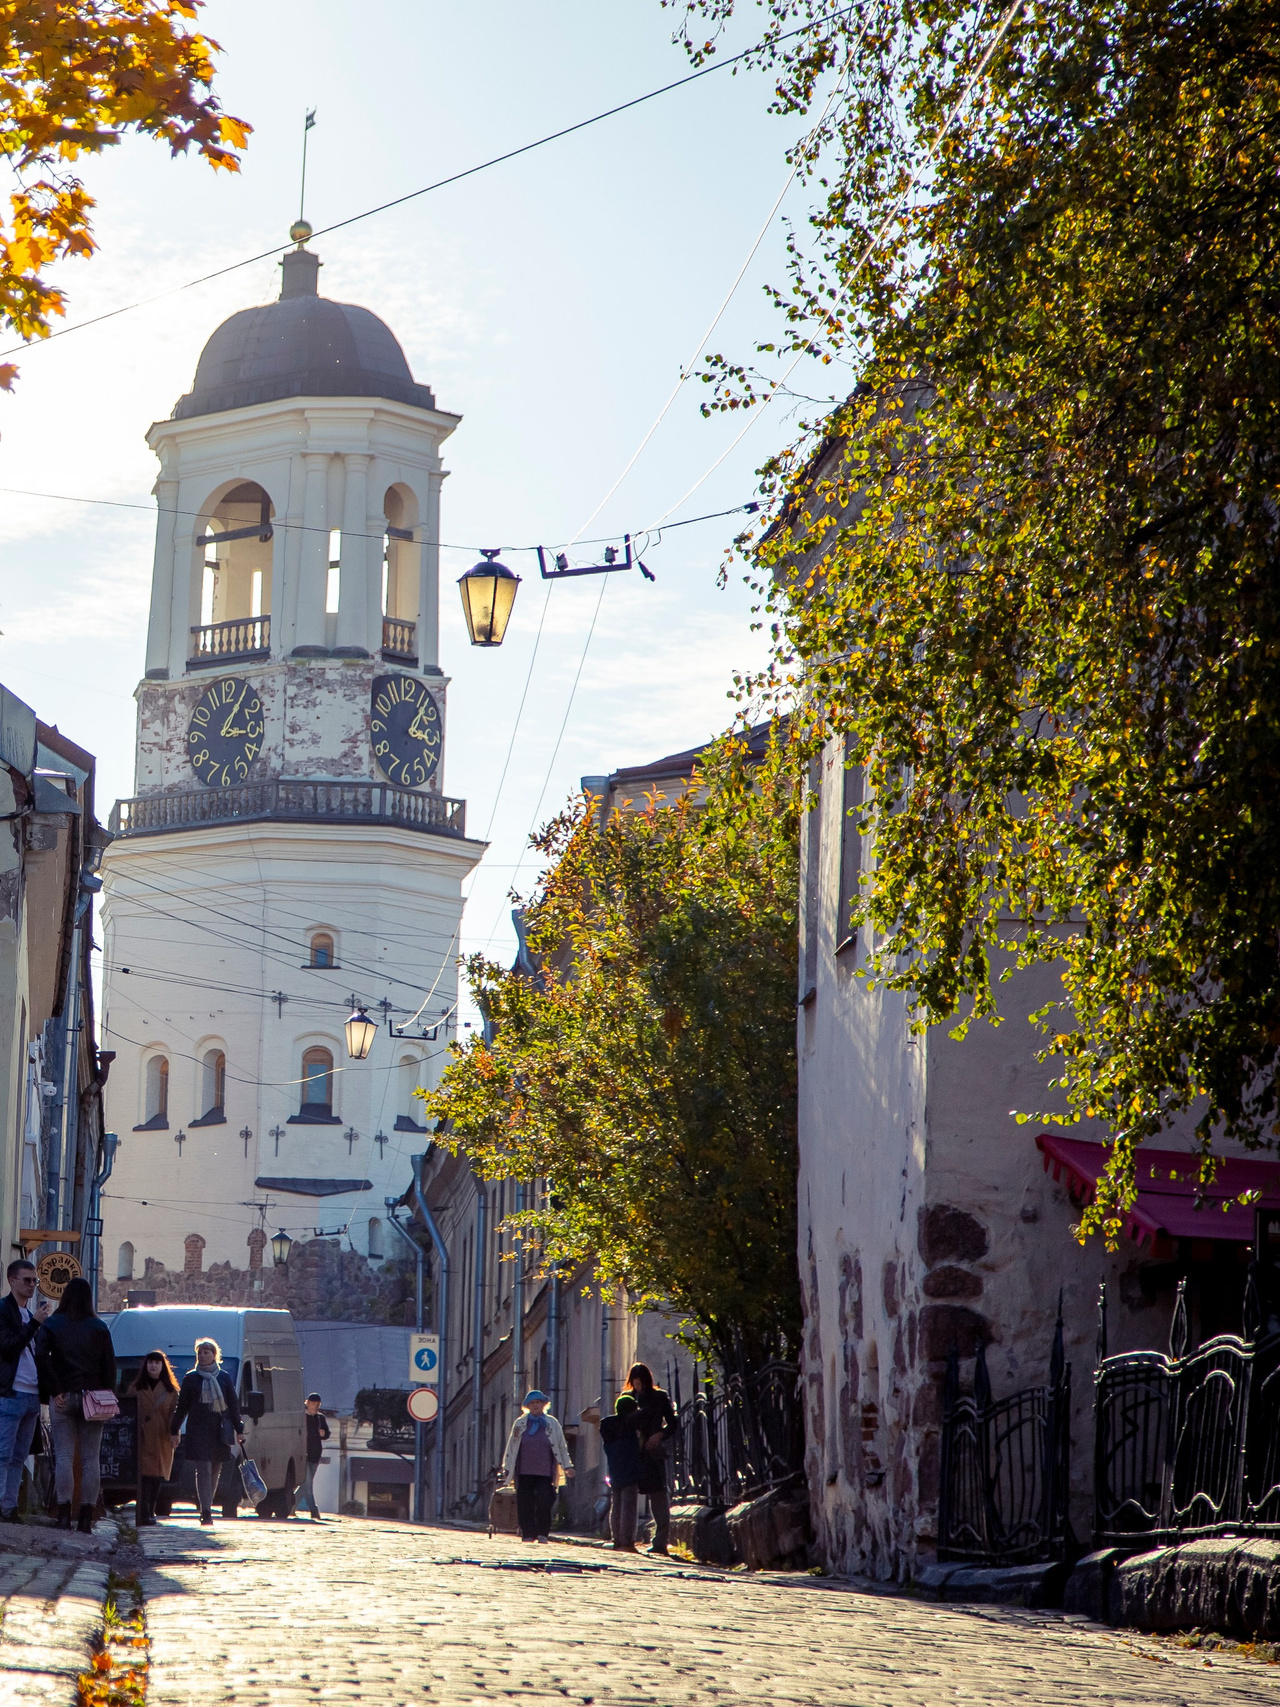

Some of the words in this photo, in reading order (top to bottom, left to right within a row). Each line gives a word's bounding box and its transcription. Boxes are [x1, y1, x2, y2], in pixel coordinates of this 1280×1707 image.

[208, 688, 220, 711] 11
[222, 680, 235, 704] 12
[387, 681, 400, 705] 11
[401, 678, 416, 702] 12
[417, 690, 426, 708] 1
[193, 707, 211, 727] 10
[244, 698, 260, 720] 2
[375, 694, 391, 718] 10
[422, 707, 437, 725] 2
[247, 721, 264, 738] 3
[371, 719, 387, 732] 9
[189, 731, 206, 743] 9
[375, 740, 390, 756] 8
[424, 728, 440, 746] 3
[193, 749, 209, 767] 8
[244, 743, 260, 761] 4
[423, 748, 438, 768] 4
[207, 760, 220, 783] 7
[221, 764, 231, 786] 6
[234, 756, 248, 779] 5
[388, 753, 400, 776] 7
[401, 763, 411, 785] 6
[414, 757, 425, 783] 5
